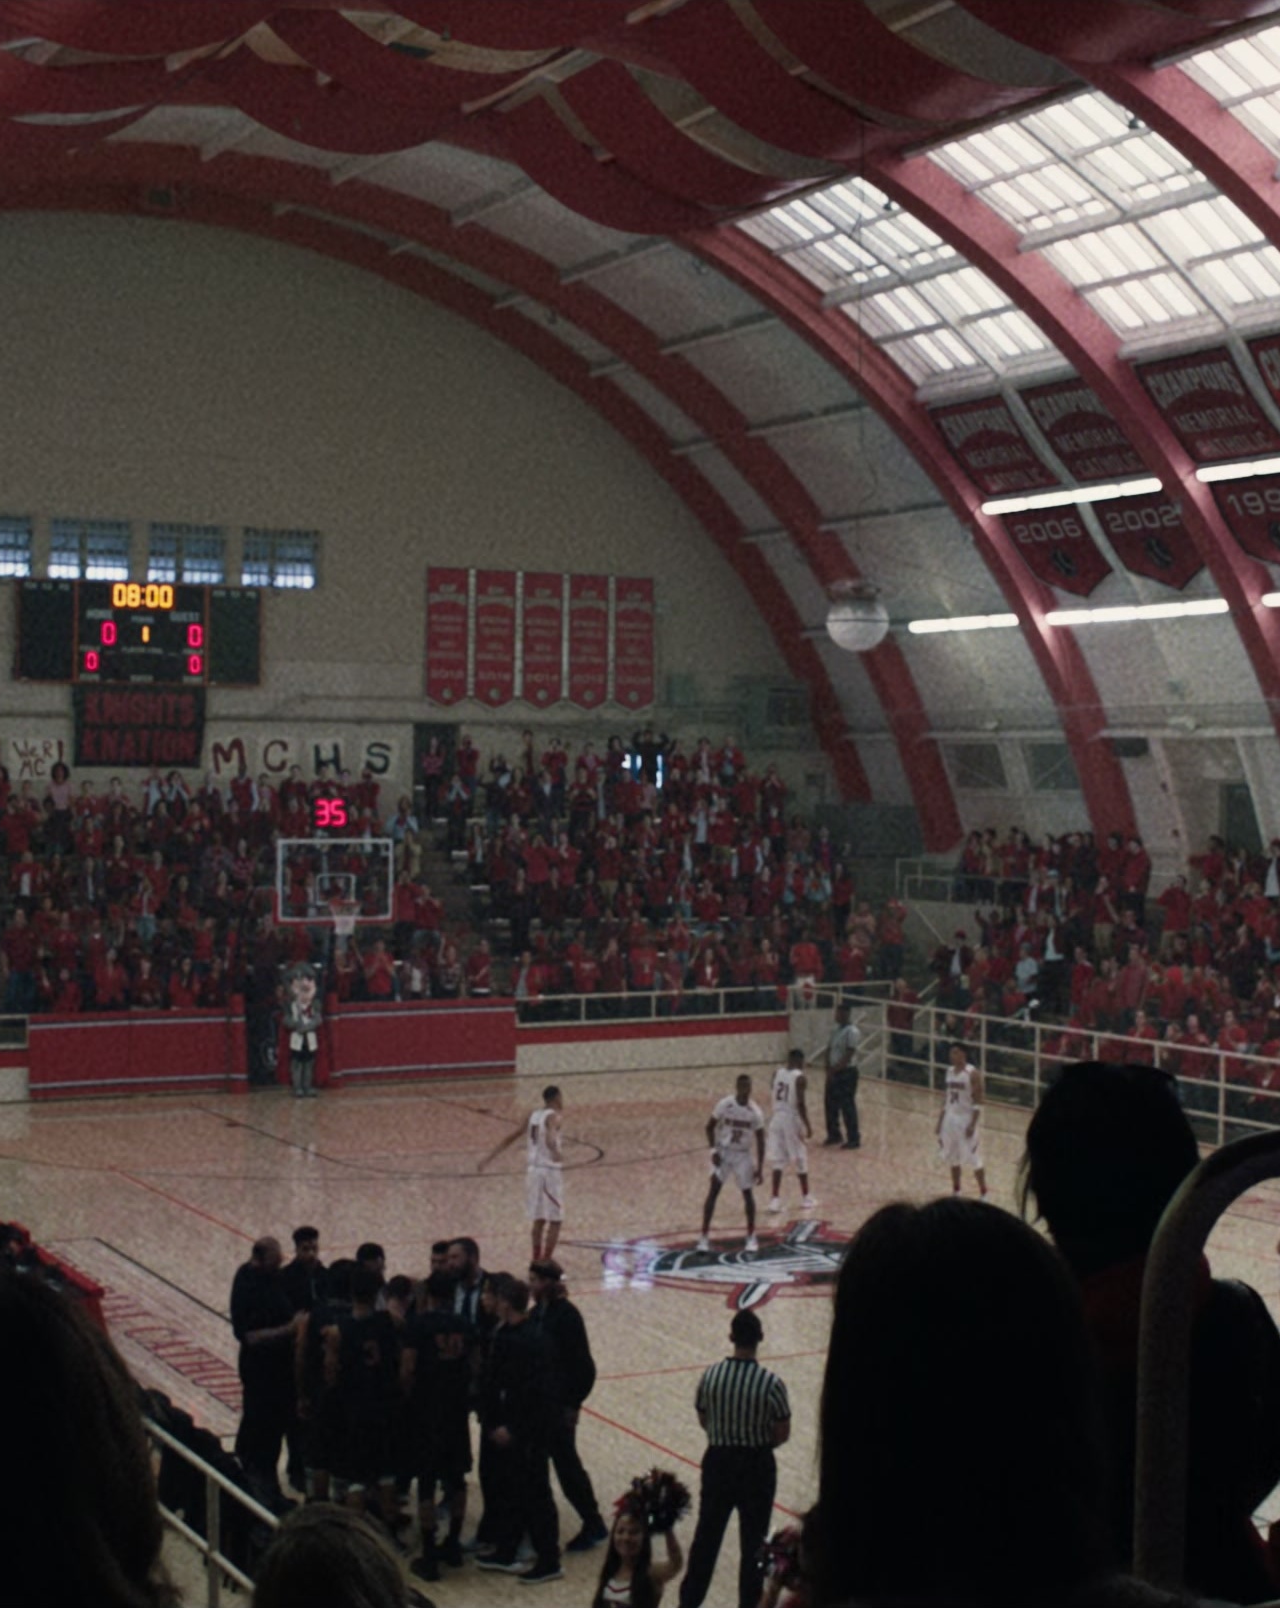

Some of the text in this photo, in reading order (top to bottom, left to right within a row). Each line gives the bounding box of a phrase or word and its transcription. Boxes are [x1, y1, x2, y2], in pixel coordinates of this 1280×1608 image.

[1146, 361, 1245, 409] CHAMPIONS
[1174, 404, 1260, 433] MEMORIAL
[1195, 431, 1271, 458] CATHOLIC
[1014, 517, 1082, 544] 2006
[1107, 505, 1180, 532] 2002
[113, 583, 174, 608] 08:00
[101, 621, 117, 645] 0
[141, 625, 150, 643] 1
[187, 624, 203, 648] 0
[85, 651, 99, 670] 0
[188, 654, 202, 674] 0
[314, 799, 347, 828] 35
